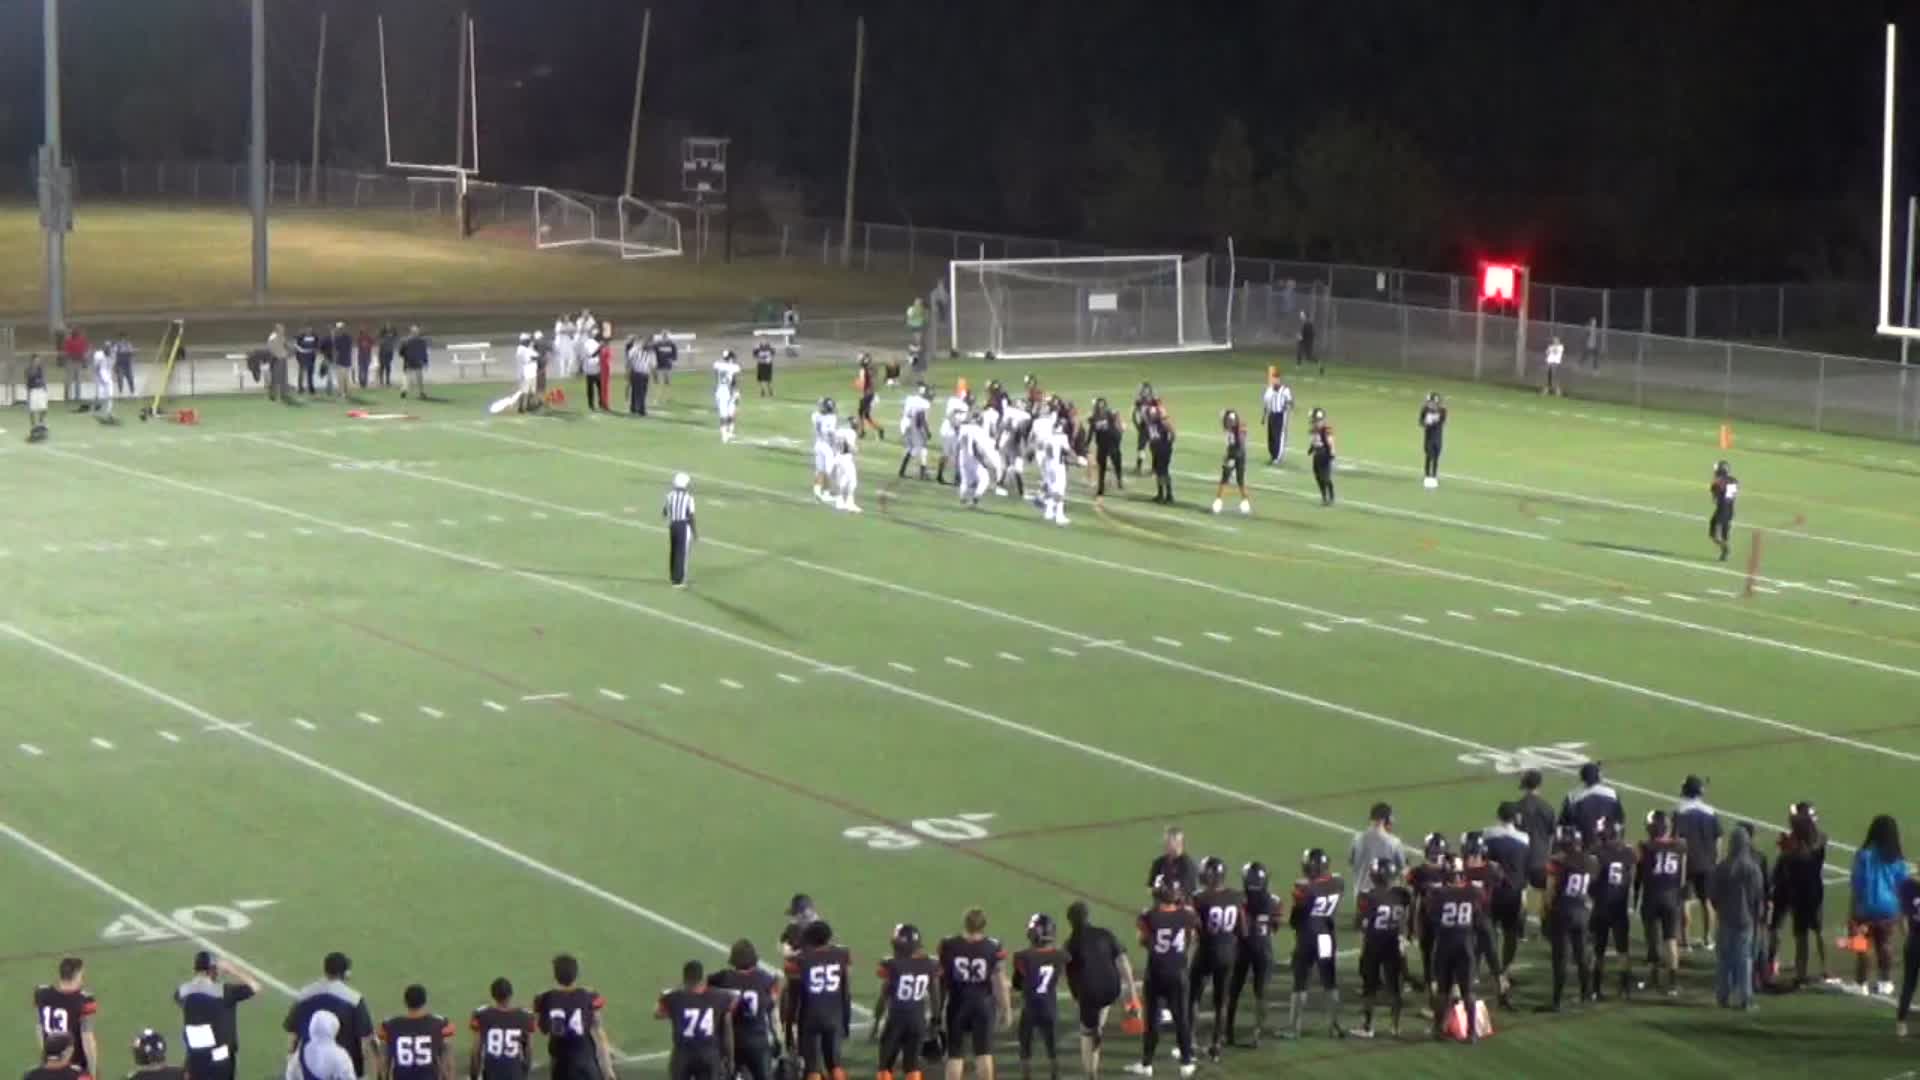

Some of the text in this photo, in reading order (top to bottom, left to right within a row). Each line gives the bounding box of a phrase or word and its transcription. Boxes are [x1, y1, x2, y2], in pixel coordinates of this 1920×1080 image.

[842, 817, 988, 849] 30
[1311, 894, 1340, 917] 27
[1441, 902, 1473, 926] 28
[102, 904, 251, 942] 40
[1154, 928, 1185, 953] 54
[809, 963, 841, 994] 55
[896, 974, 929, 1001] 60
[1036, 964, 1055, 994] 7
[42, 1005, 69, 1033] 13
[683, 1007, 715, 1037] 74
[396, 1034, 433, 1067] 65
[486, 1027, 523, 1057] 85
